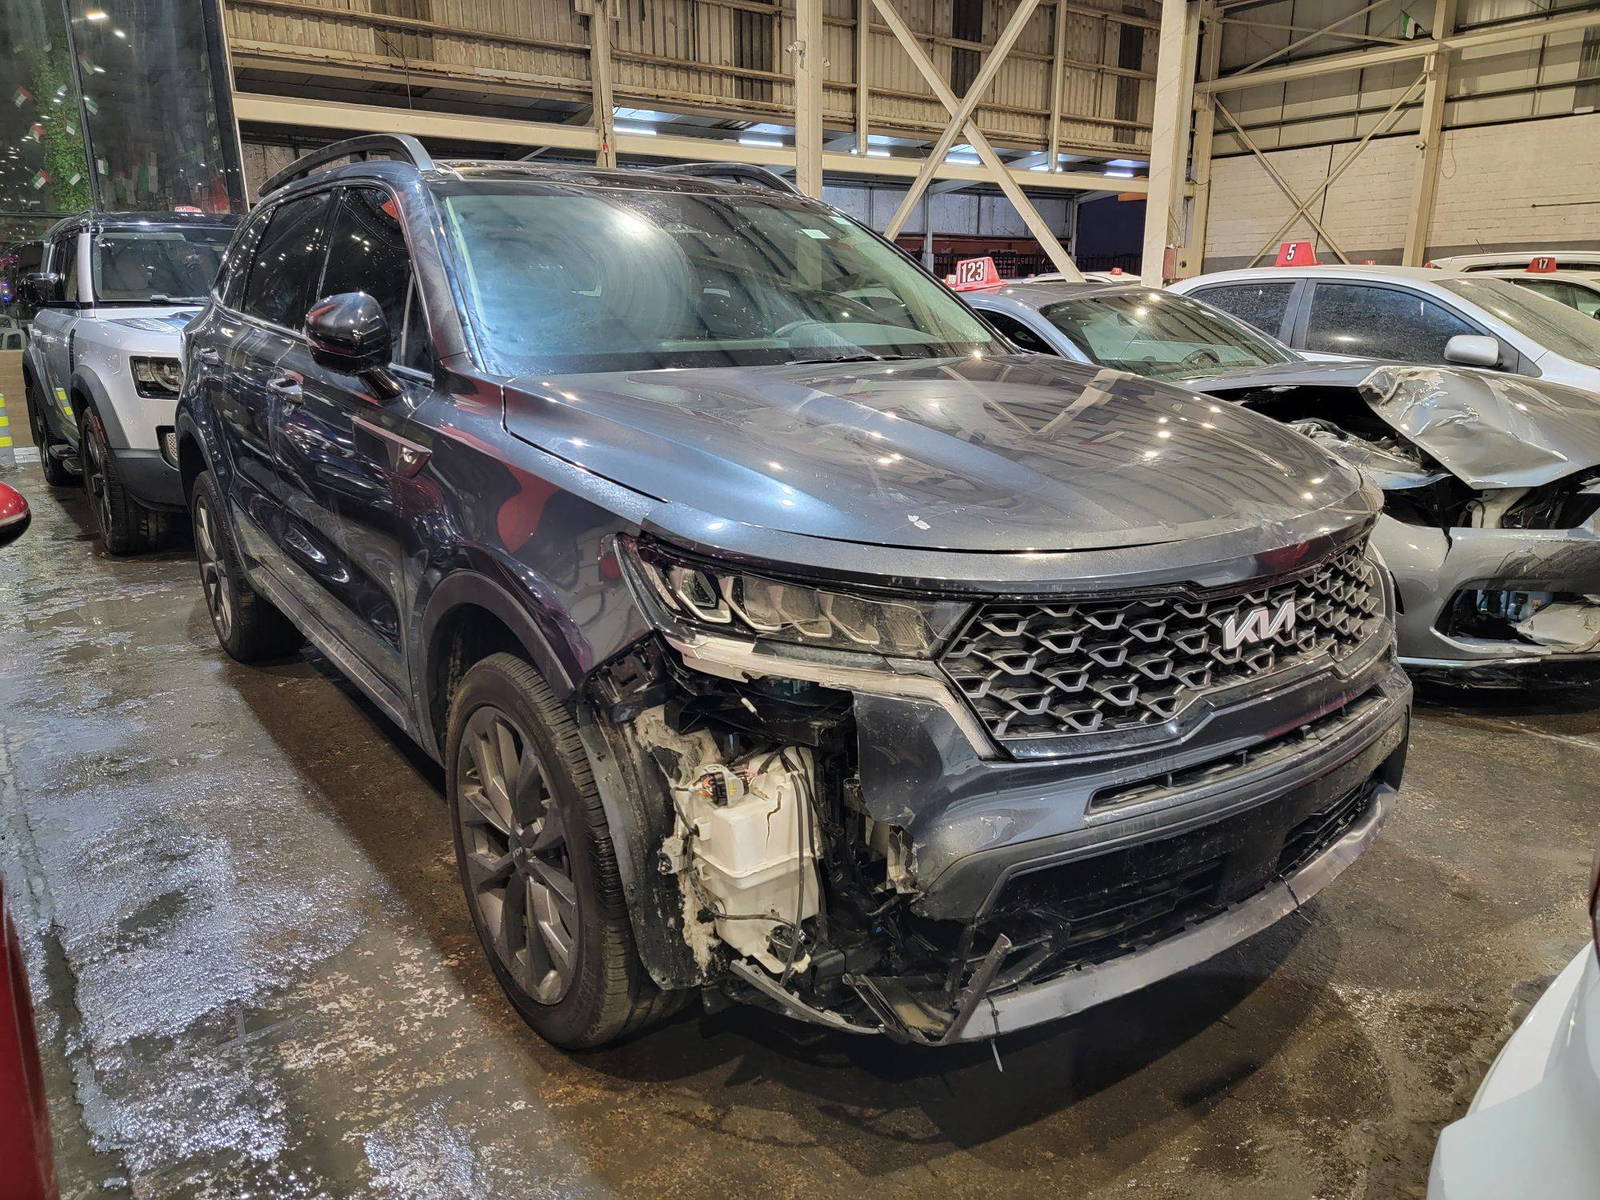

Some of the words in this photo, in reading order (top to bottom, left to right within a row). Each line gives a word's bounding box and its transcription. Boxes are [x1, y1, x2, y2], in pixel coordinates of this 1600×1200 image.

[1286, 243, 1297, 261] 5
[961, 261, 984, 283] 123
[1538, 258, 1549, 270] 17
[1223, 598, 1296, 651] KIA
